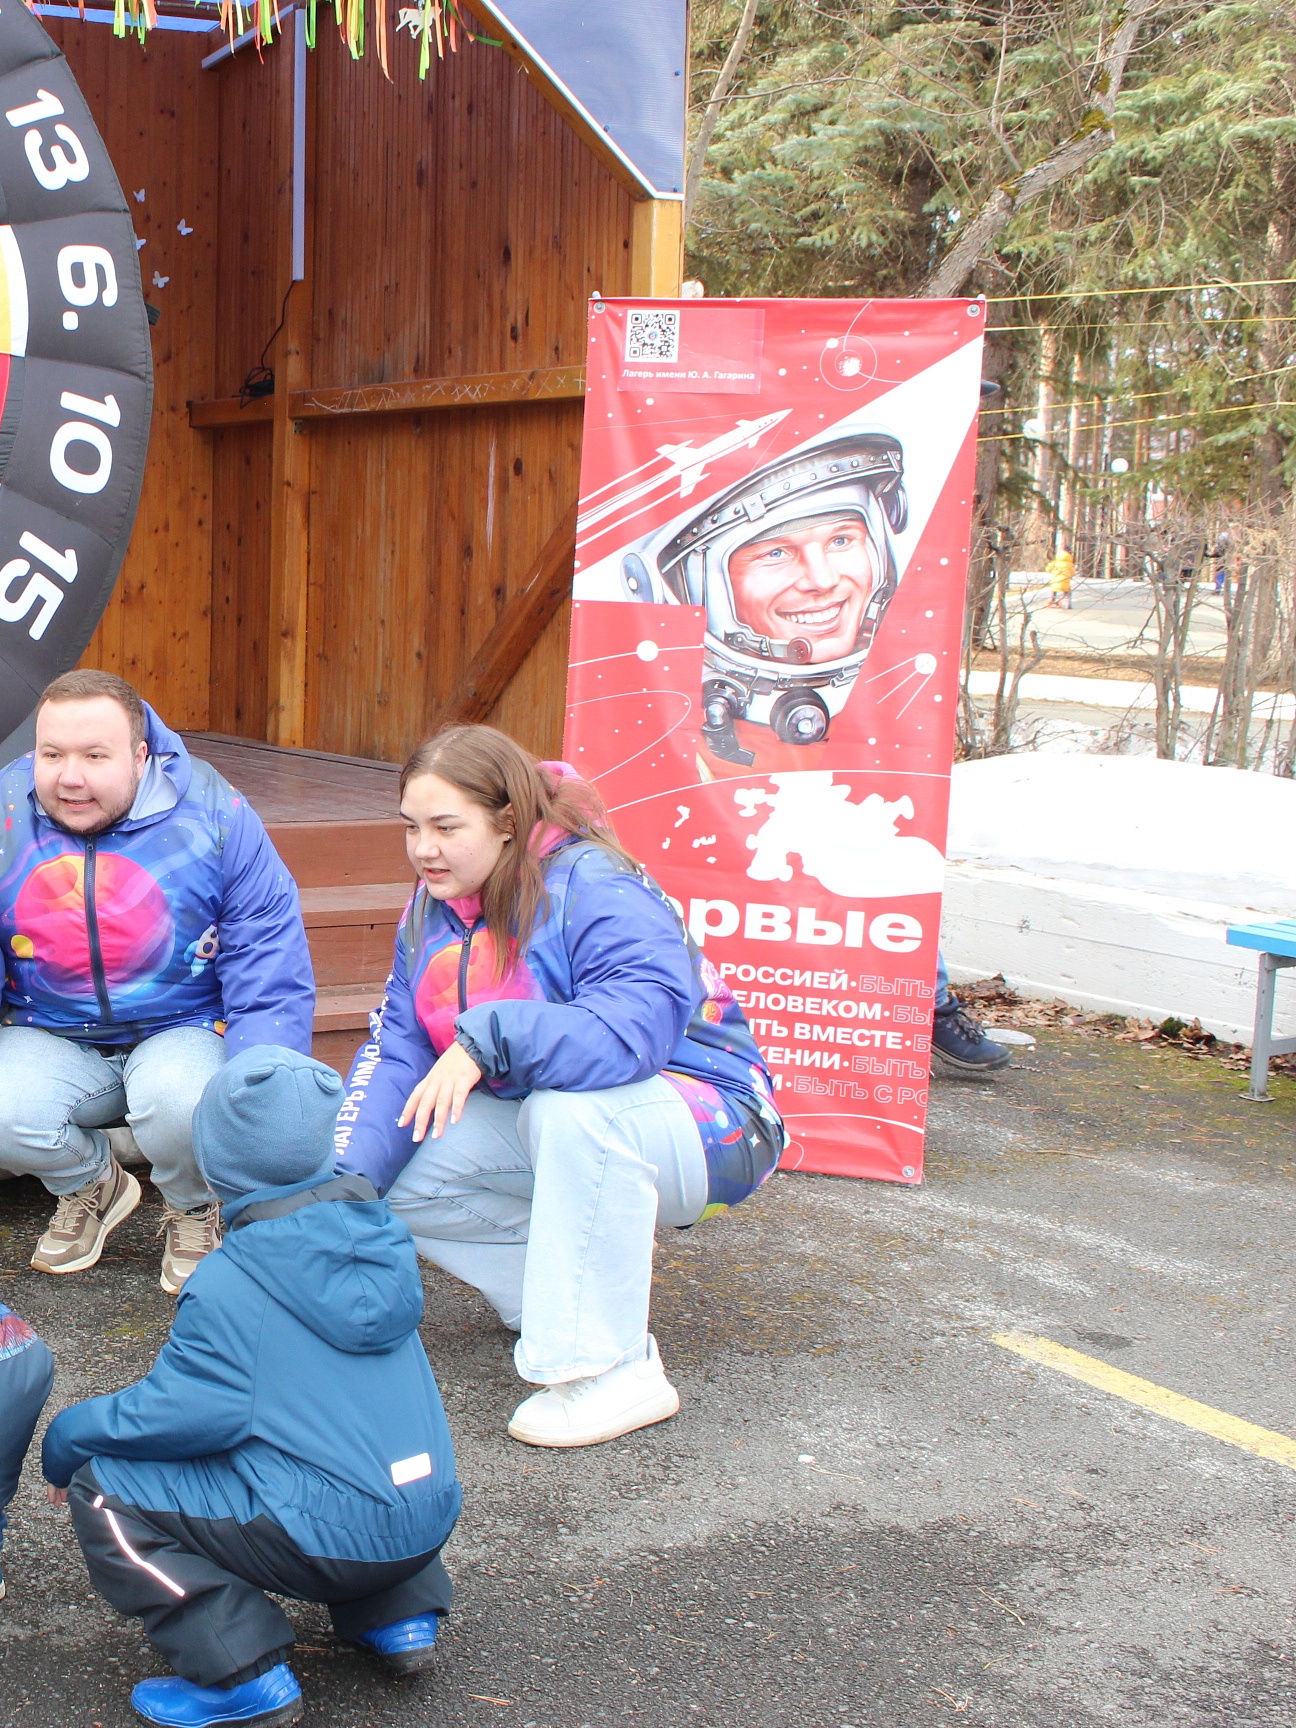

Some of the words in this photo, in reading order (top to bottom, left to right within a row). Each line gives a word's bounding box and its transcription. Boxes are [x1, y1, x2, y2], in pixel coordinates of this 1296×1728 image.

[6, 88, 90, 191] 13
[621, 369, 654, 379] Лагерь
[655, 371, 686, 379] имени
[688, 370, 700, 379] Ю.
[702, 370, 712, 379] А.
[714, 370, 756, 381] Гагарина
[49, 391, 121, 494] 10
[667, 895, 923, 953] рвые
[858, 974, 935, 999] БЫТЬ
[732, 989, 882, 1020] ЕЛОВЕКОМ
[794, 1022, 903, 1050] ВМЕСТЕ
[851, 1055, 927, 1079] БЫТЬ
[793, 1075, 869, 1100] БЫТЬ
[873, 1084, 893, 1103] С
